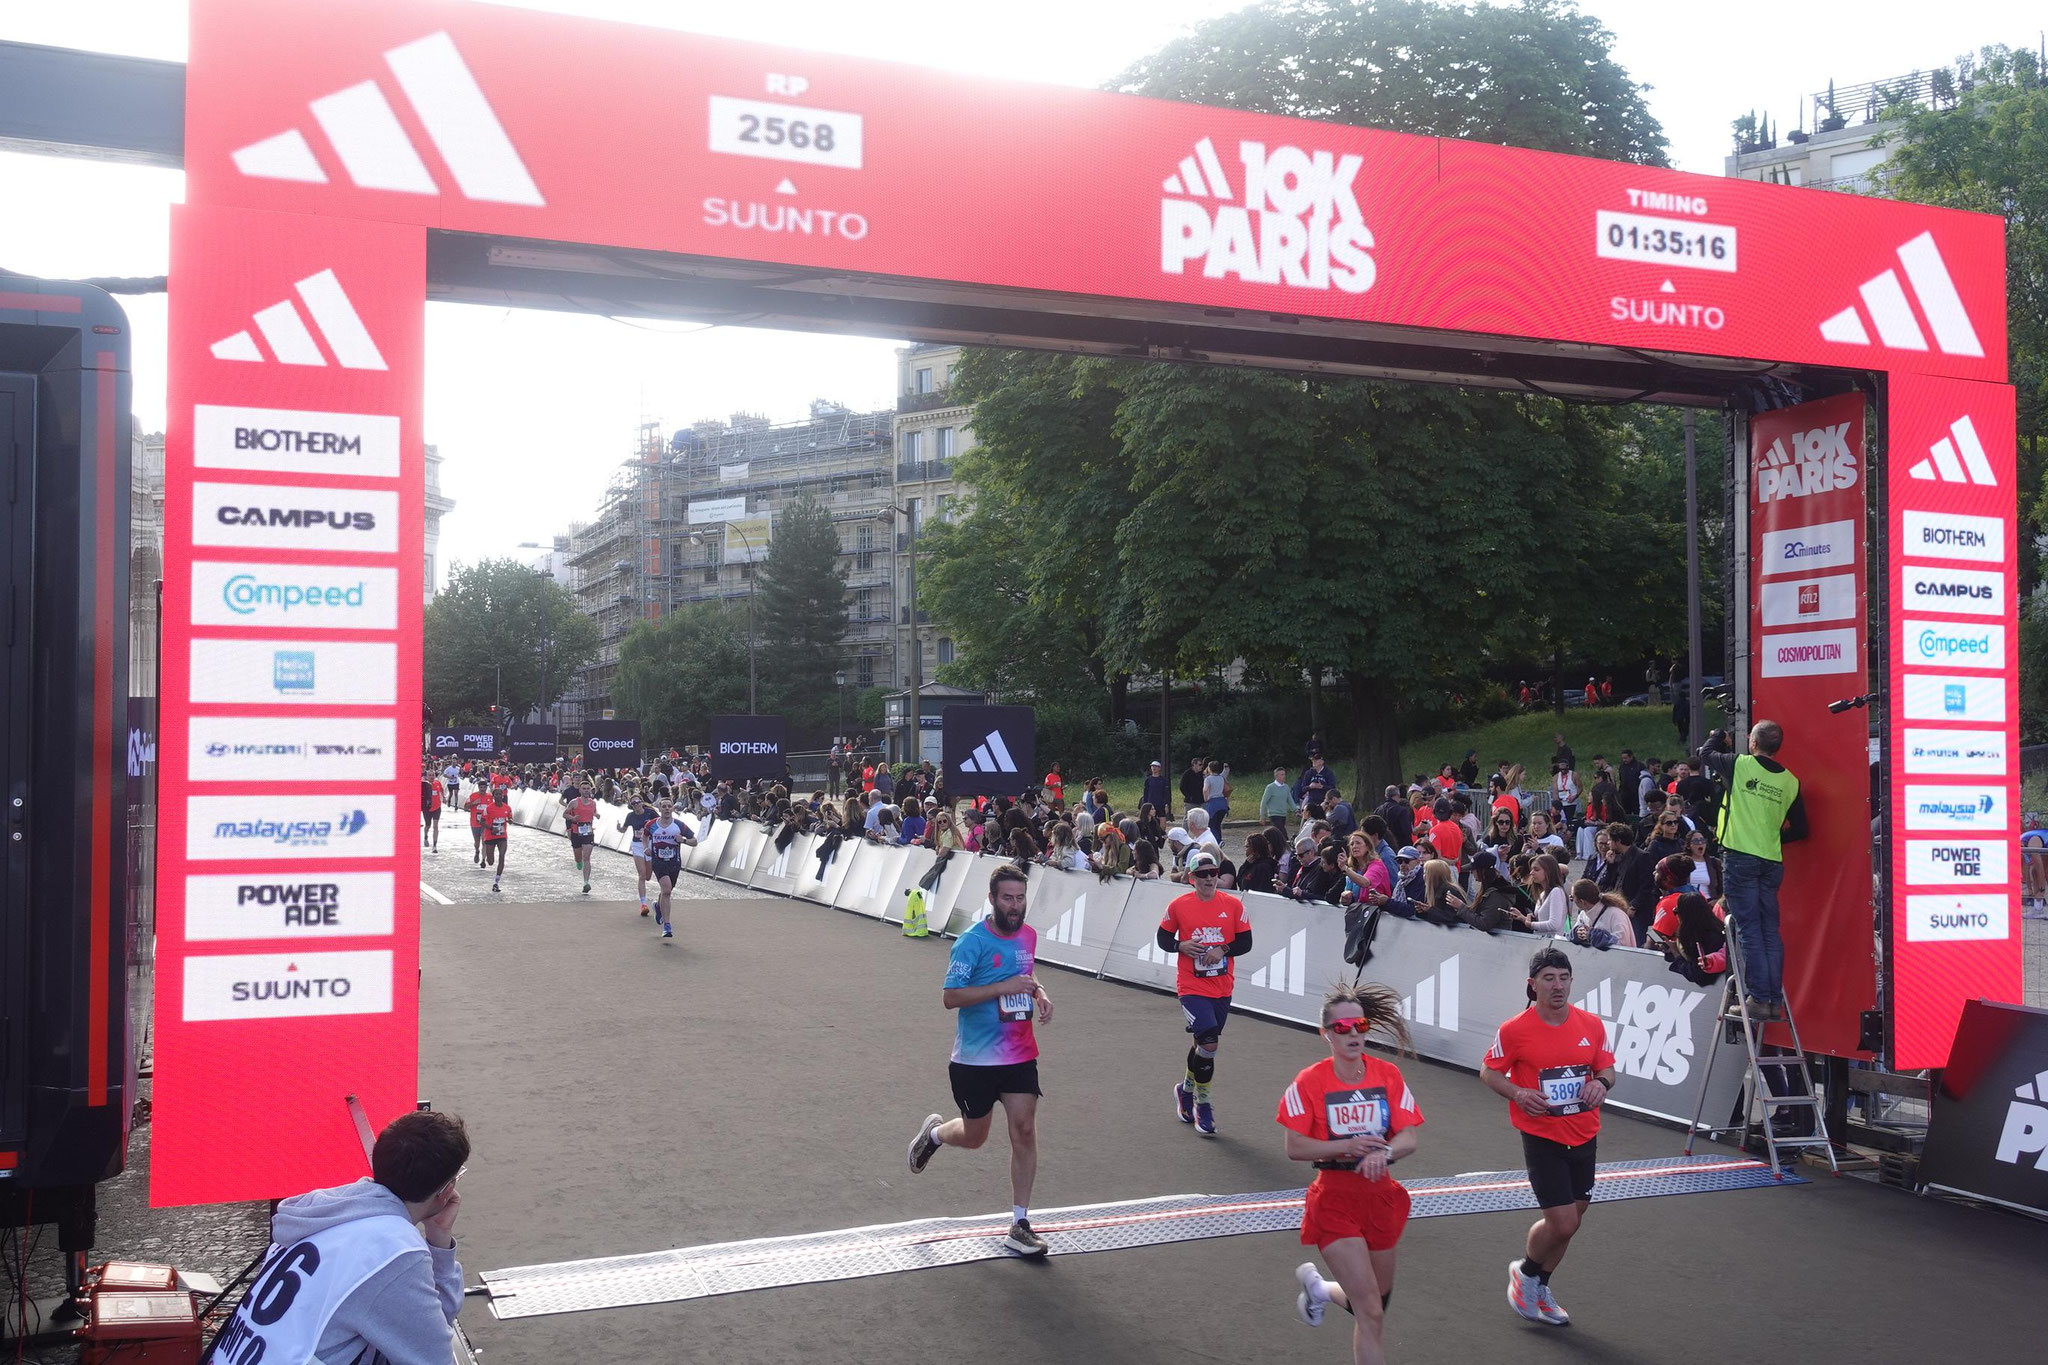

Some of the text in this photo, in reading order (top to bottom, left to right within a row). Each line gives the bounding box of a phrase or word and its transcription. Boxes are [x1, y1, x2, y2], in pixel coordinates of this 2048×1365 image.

[738, 114, 835, 152] 2568
[1239, 139, 1364, 226] 10K
[1626, 188, 1708, 216] TIMING
[702, 197, 868, 240] SUUNTO
[1161, 197, 1377, 293] PARIS
[1608, 223, 1726, 260] 01:35:16
[1610, 297, 1725, 330] SUUNTO
[234, 427, 361, 455] BIOTHERM
[1792, 421, 1852, 463] 10K
[1758, 453, 1858, 503] PARIS
[217, 505, 376, 531] CAMPUS
[1923, 527, 1985, 547] BIOTHERM
[223, 574, 364, 614] Compeed
[1800, 592, 1818, 605] RTL2
[1915, 581, 1993, 600] CAMPUS
[1777, 643, 1841, 663] COSMOPOLITAN
[1919, 629, 1989, 658] Compeed
[463, 734, 494, 742] POWER
[477, 741, 494, 749] ADE
[588, 737, 634, 751] Compeed
[720, 742, 777, 754] BIOTHERM
[1919, 801, 1976, 819] malaysia
[214, 818, 333, 843] malaysia
[1932, 848, 1981, 862] POWER
[1954, 862, 1981, 876] ADE
[237, 883, 339, 906] POWER
[284, 904, 340, 926] ADE
[1930, 913, 1988, 928] SUUNTO
[231, 978, 351, 1001] SUUNTO
[1617, 980, 1706, 1039] 10K
[1550, 1081, 1582, 1101] 3892
[1334, 1103, 1375, 1125] 18477
